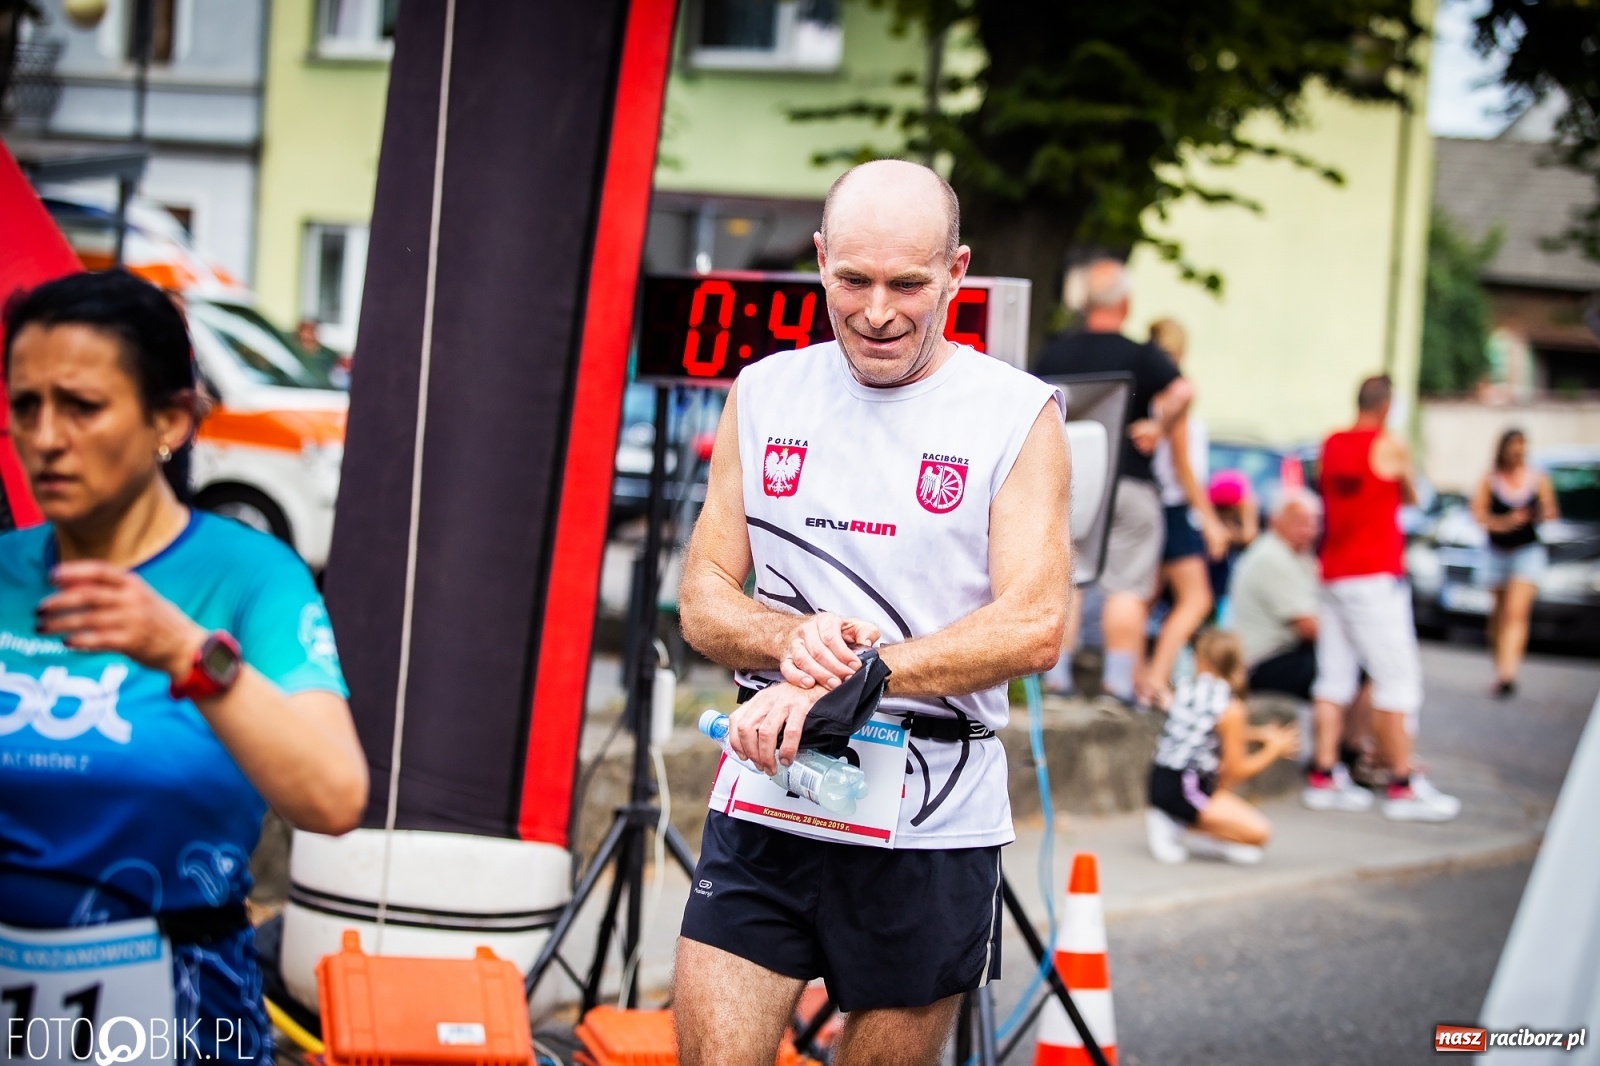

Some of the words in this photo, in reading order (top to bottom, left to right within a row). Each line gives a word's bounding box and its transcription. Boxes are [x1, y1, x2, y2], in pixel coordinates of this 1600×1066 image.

[767, 436, 809, 447] POLSKA
[922, 452, 970, 466] RACIBÓRZ
[854, 725, 900, 743] WICKI
[763, 807, 802, 823] Krzanowice,
[802, 816, 813, 824] 28
[812, 817, 827, 827] lipca
[827, 821, 845, 831] 2019
